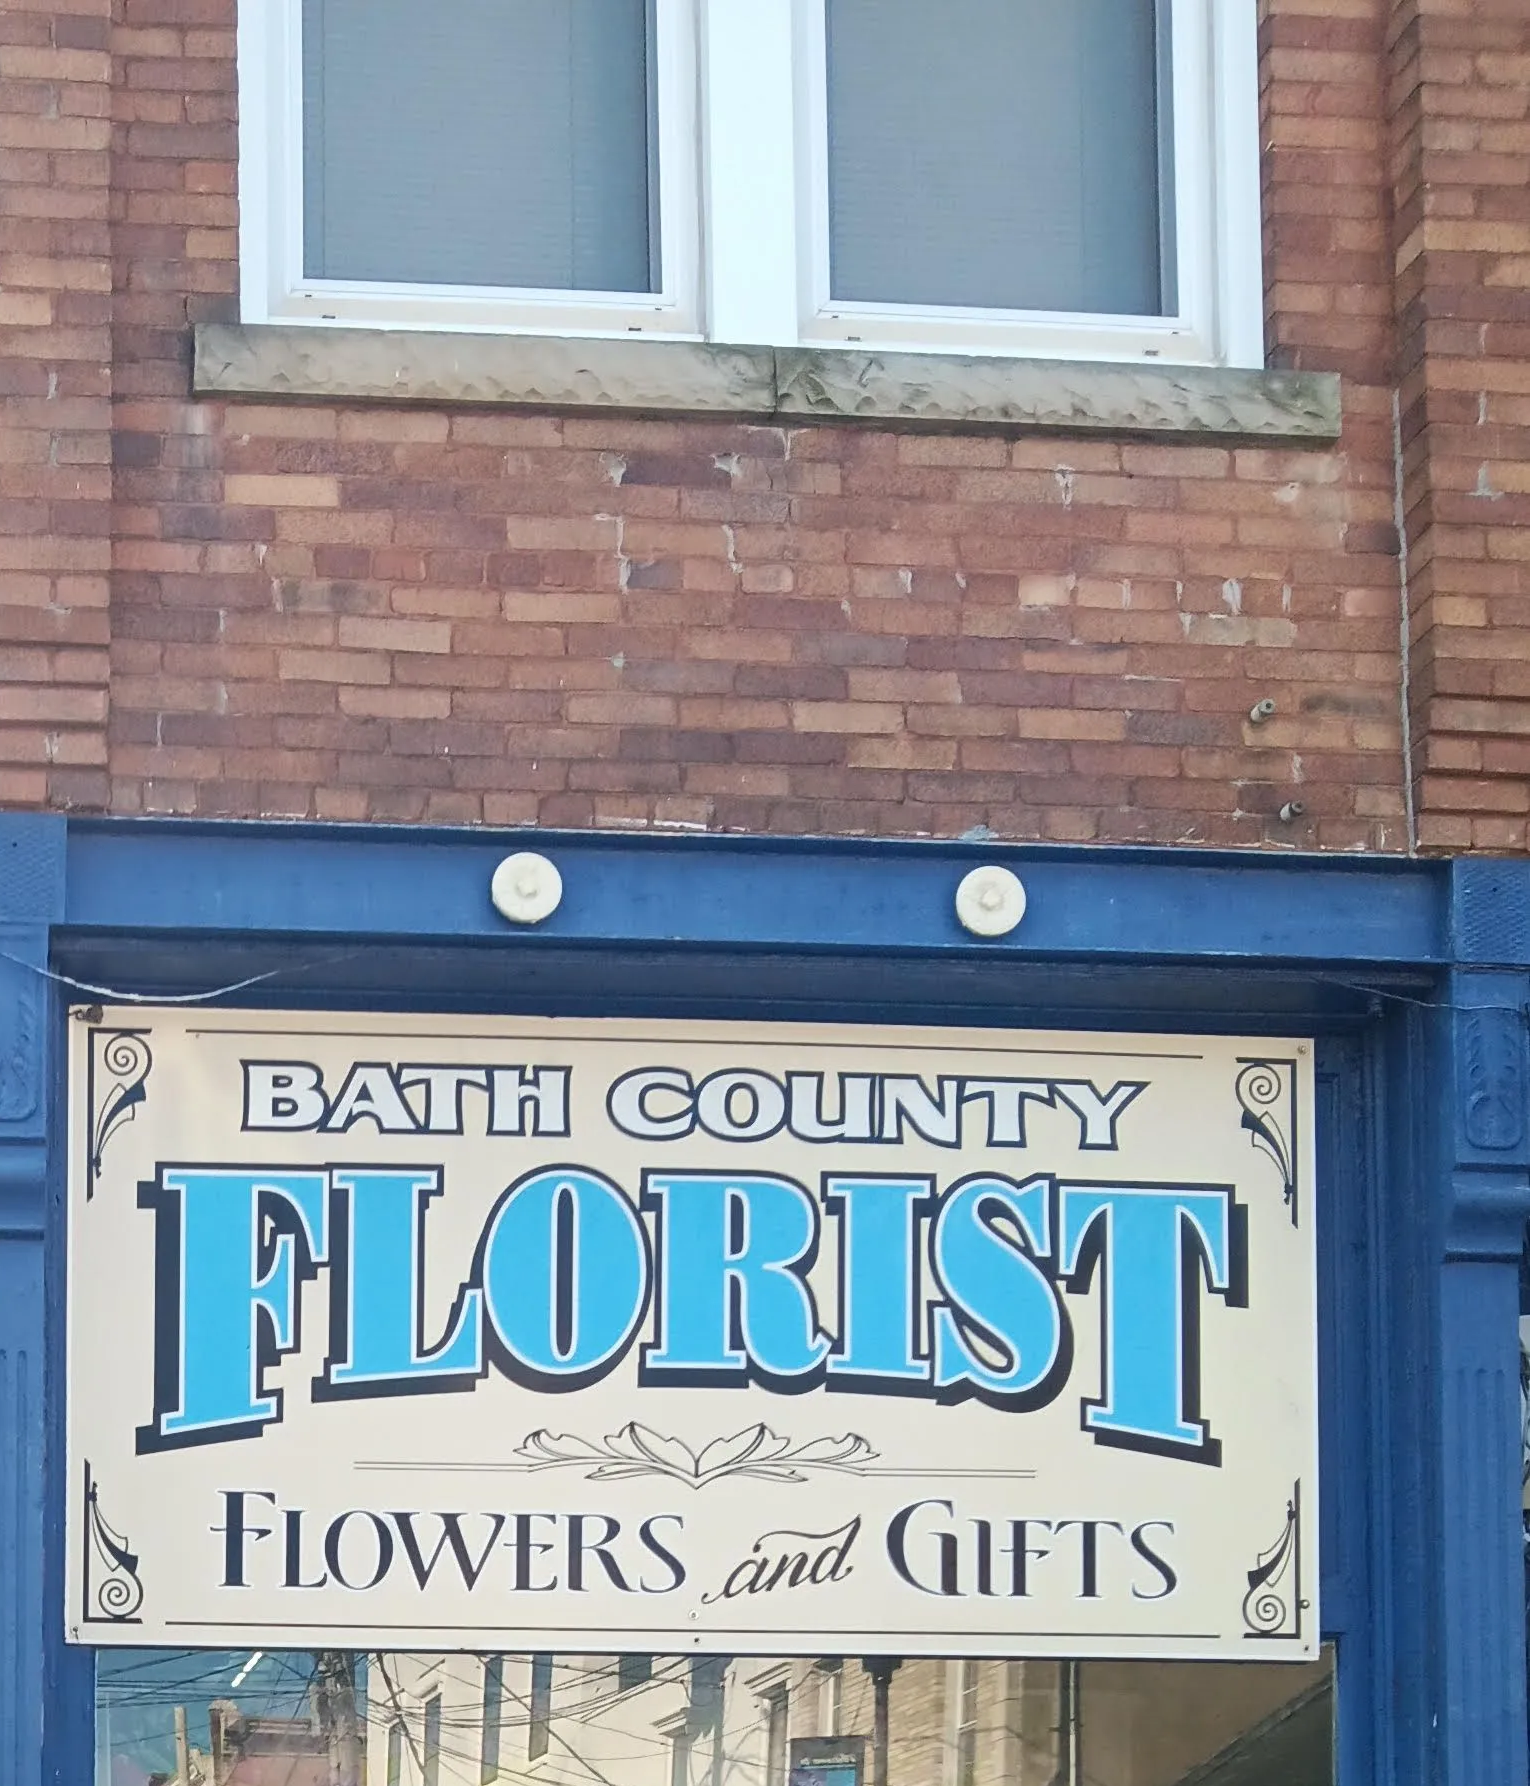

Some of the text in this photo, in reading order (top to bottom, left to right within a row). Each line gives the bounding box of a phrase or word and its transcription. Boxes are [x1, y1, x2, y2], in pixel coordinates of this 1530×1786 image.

[241, 1059, 1149, 1150] BATH COUNTY
[136, 1161, 1249, 1467] FLORIST
[211, 1490, 1178, 1605] FLOWERS and GIFTS
